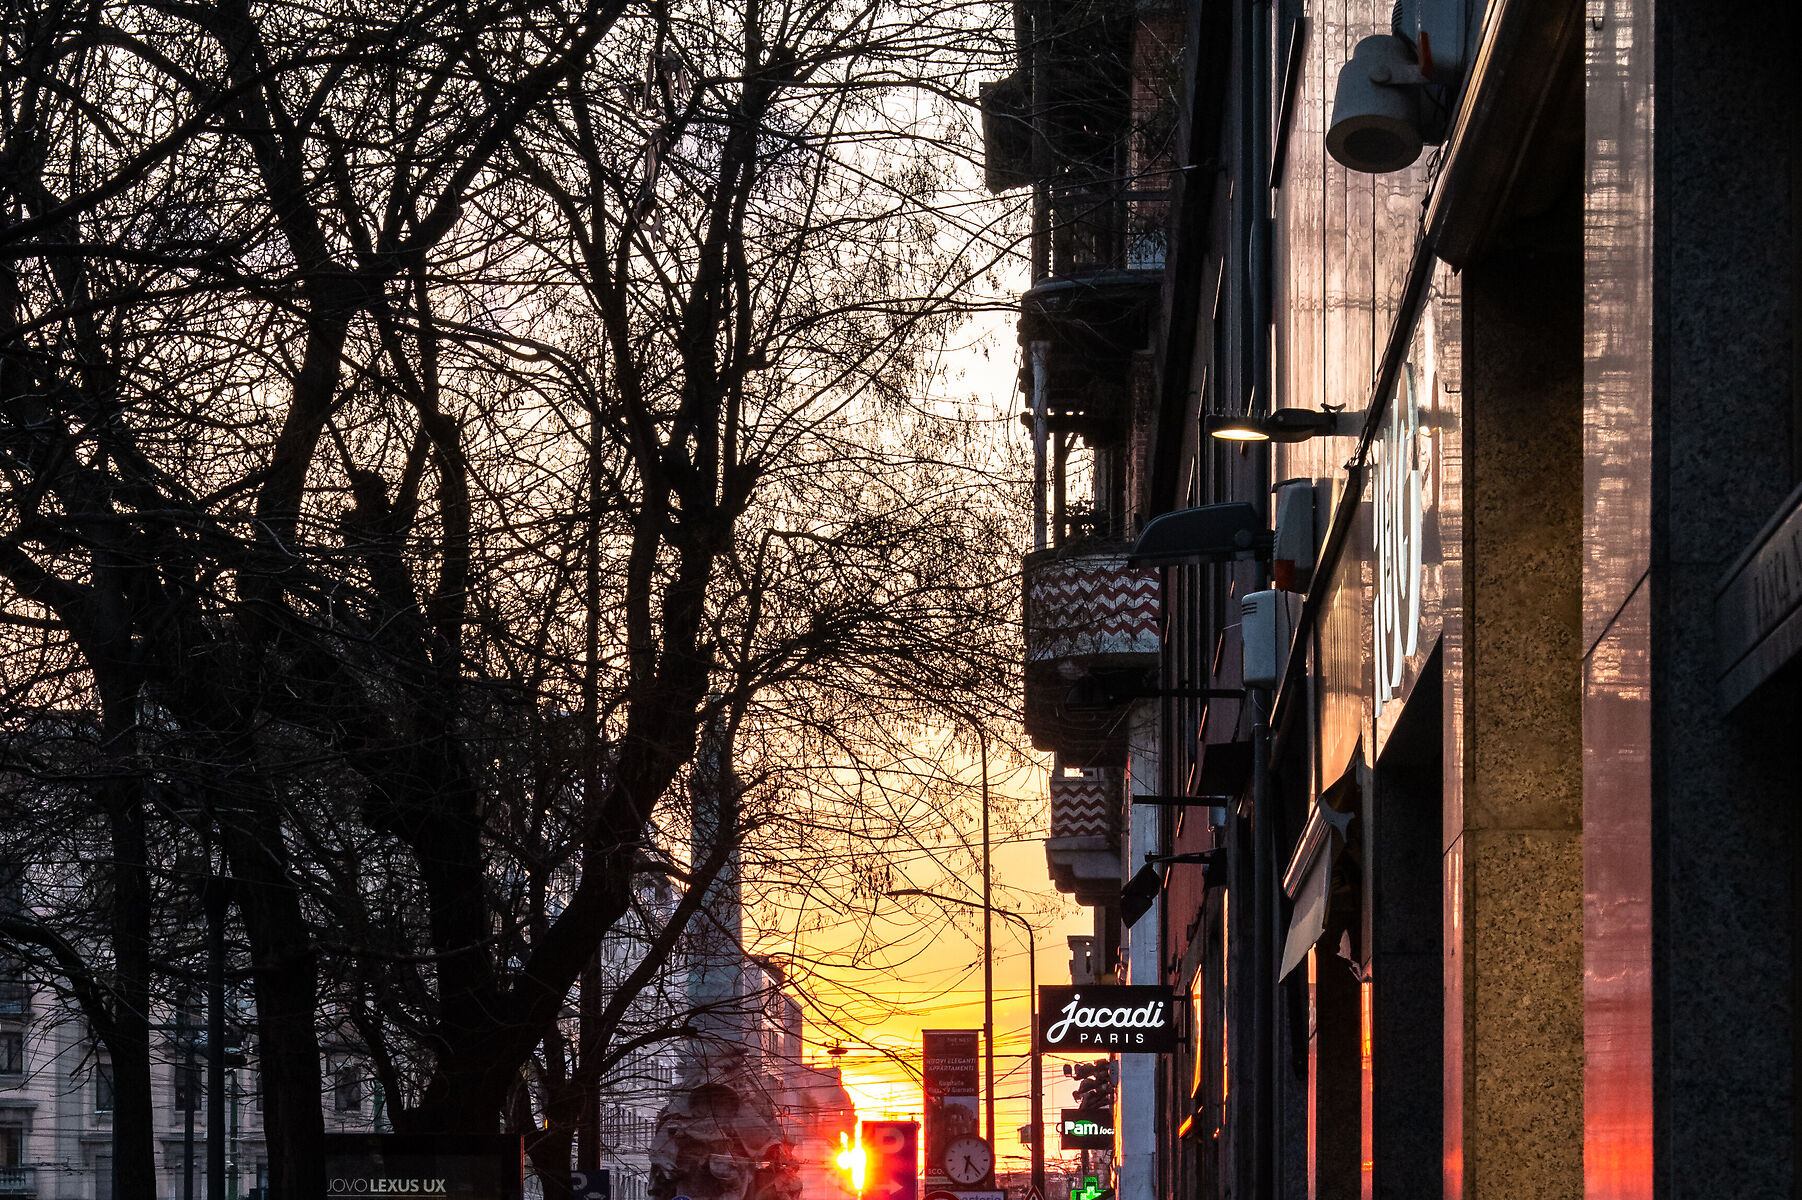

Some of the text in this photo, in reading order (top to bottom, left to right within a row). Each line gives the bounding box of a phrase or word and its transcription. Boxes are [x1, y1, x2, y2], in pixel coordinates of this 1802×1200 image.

[1046, 993, 1165, 1044] jacadi
[1080, 1033, 1145, 1044] PARIS
[1064, 1120, 1099, 1135] Pam
[370, 1178, 419, 1193] LEXUS
[423, 1178, 446, 1193] UX
